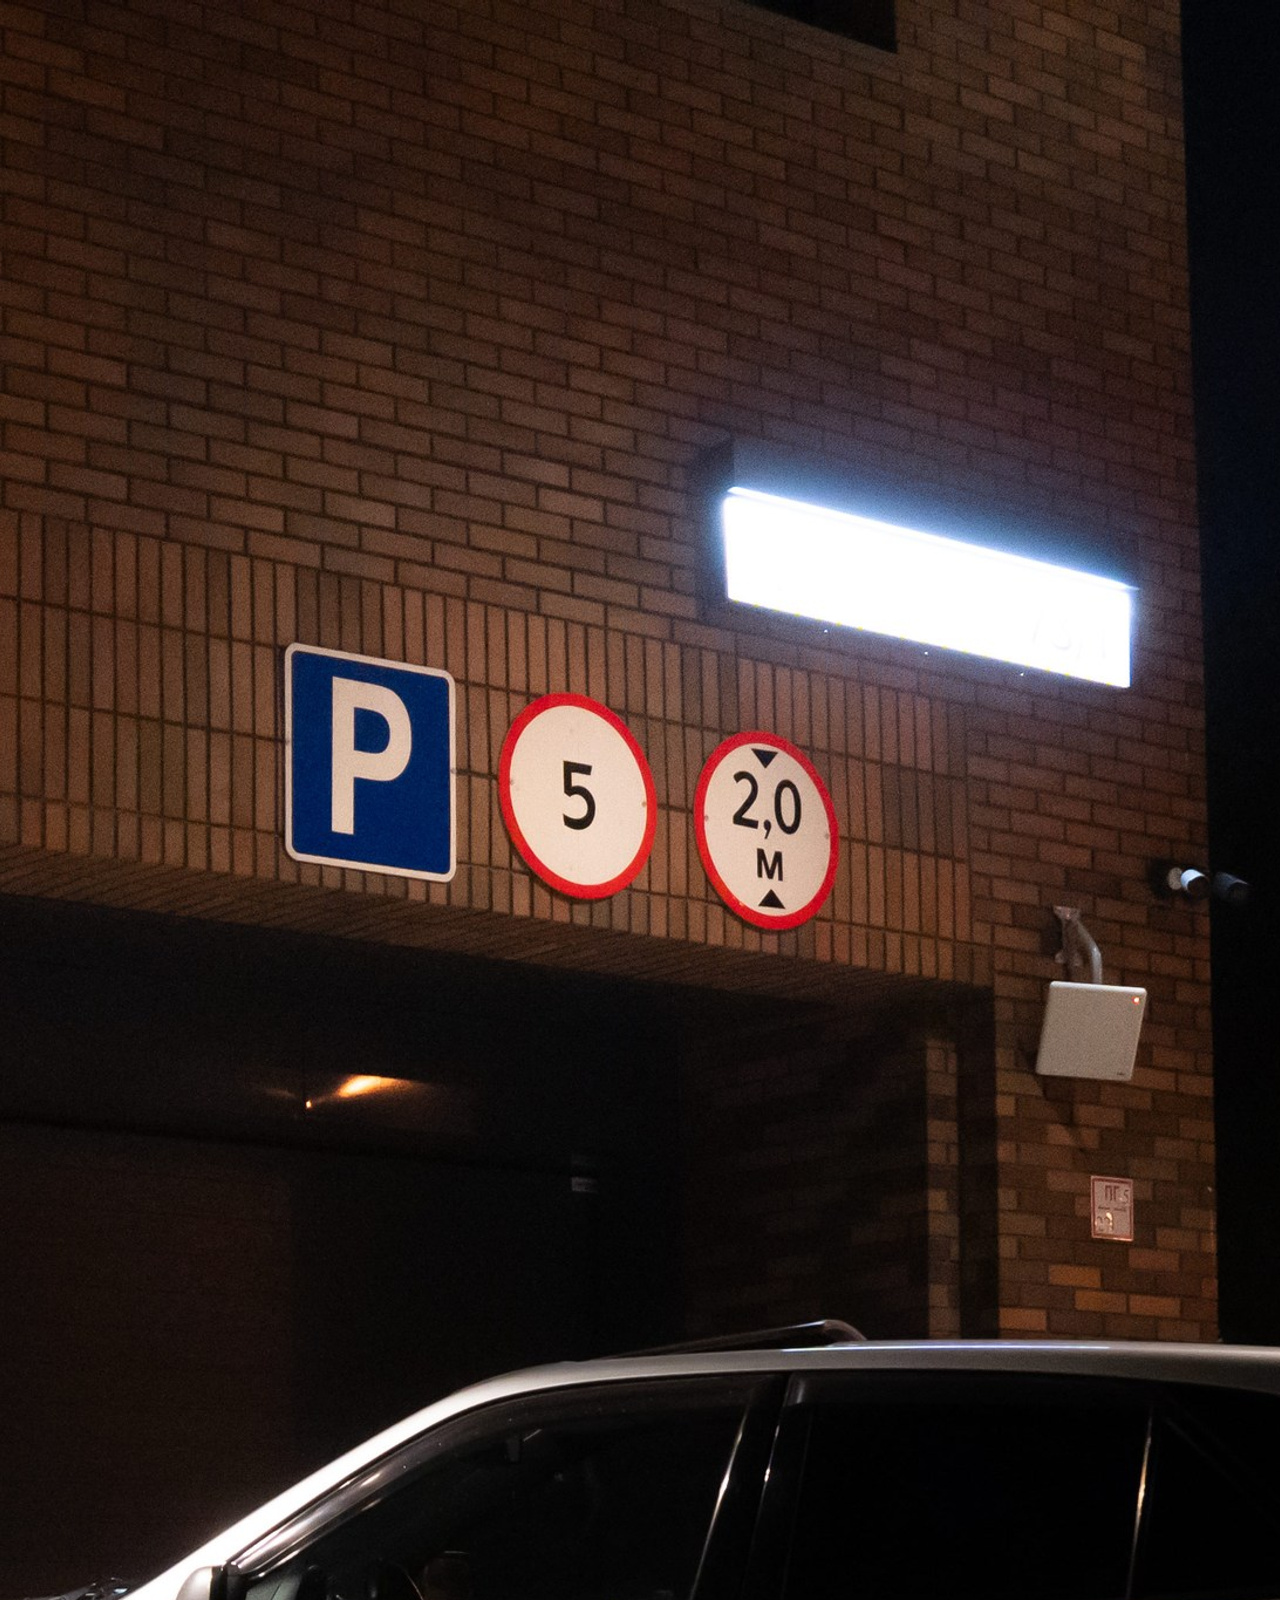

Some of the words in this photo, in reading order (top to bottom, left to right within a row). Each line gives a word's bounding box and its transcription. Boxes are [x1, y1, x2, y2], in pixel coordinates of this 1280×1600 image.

[331, 676, 412, 836] P
[562, 760, 596, 830] 5
[732, 770, 802, 840] 2,0
